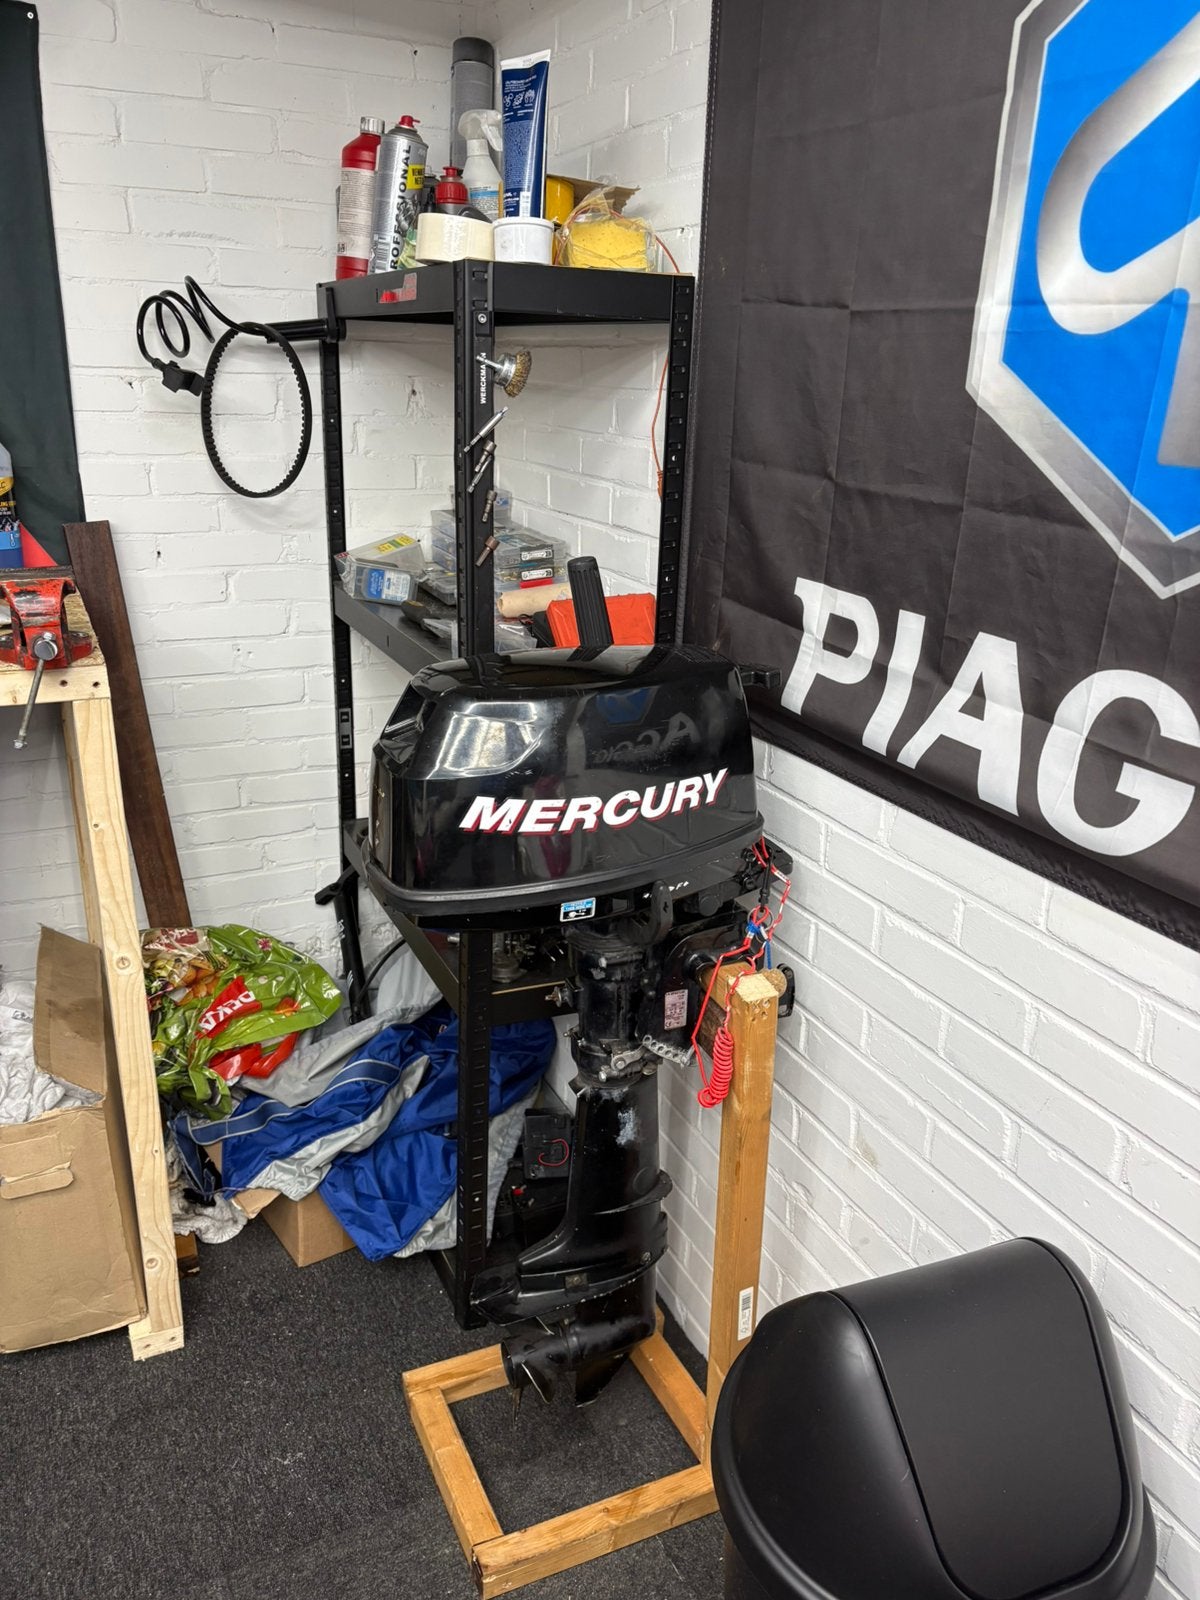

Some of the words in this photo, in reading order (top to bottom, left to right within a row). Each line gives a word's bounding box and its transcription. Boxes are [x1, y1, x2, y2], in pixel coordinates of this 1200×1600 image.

[780, 577, 1200, 857] PIAG
[459, 768, 729, 836] MERCURY
[200, 991, 256, 1031] DEKA
